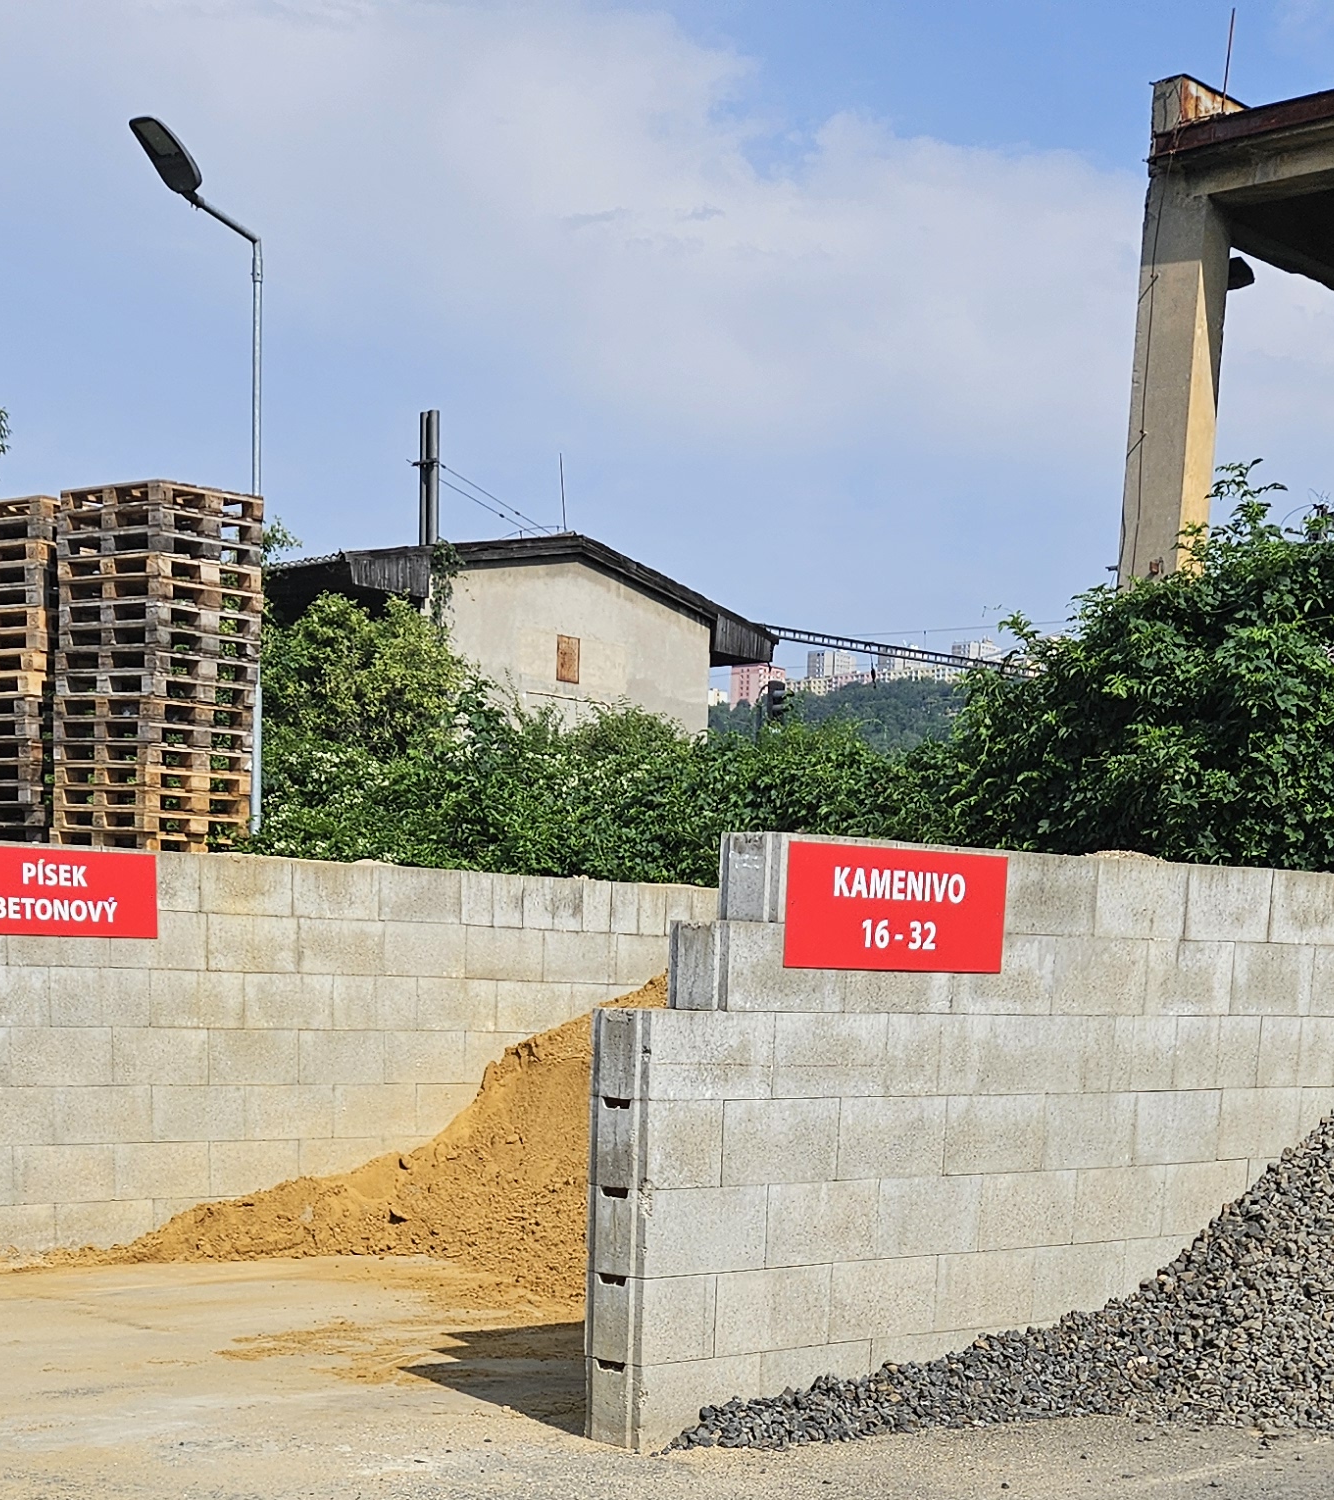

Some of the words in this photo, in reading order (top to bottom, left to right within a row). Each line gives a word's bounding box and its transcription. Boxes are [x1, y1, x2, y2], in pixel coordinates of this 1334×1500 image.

[22, 858, 88, 887] PÍSEK
[833, 866, 966, 904] KAMENIVO
[862, 918, 889, 949] 16
[894, 933, 904, 941] -
[907, 920, 937, 950] 32
